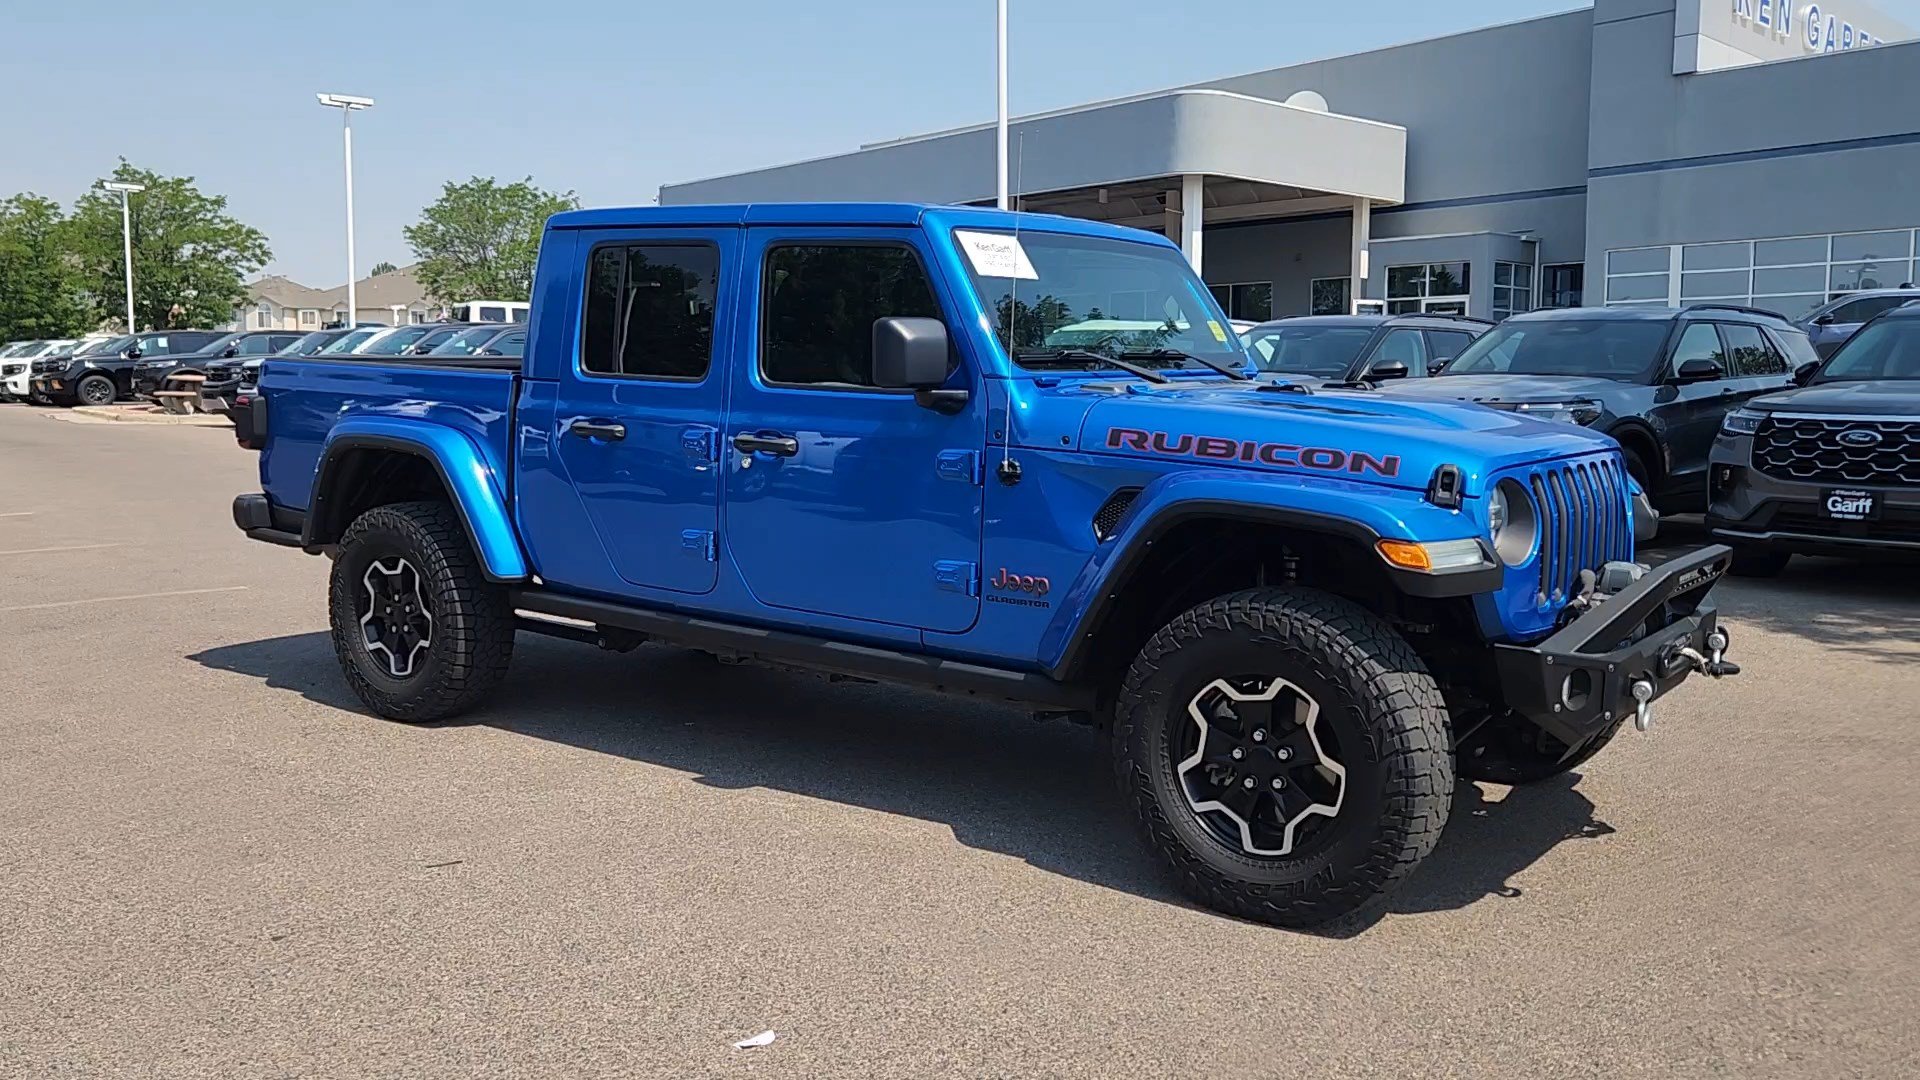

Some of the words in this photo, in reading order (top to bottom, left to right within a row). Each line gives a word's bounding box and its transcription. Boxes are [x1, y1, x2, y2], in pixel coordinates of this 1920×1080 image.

[1106, 426, 1401, 479] RUBICON
[1826, 496, 1872, 514] Garff
[990, 567, 1049, 598] Jeep
[985, 594, 1050, 609] GLADIATOR
